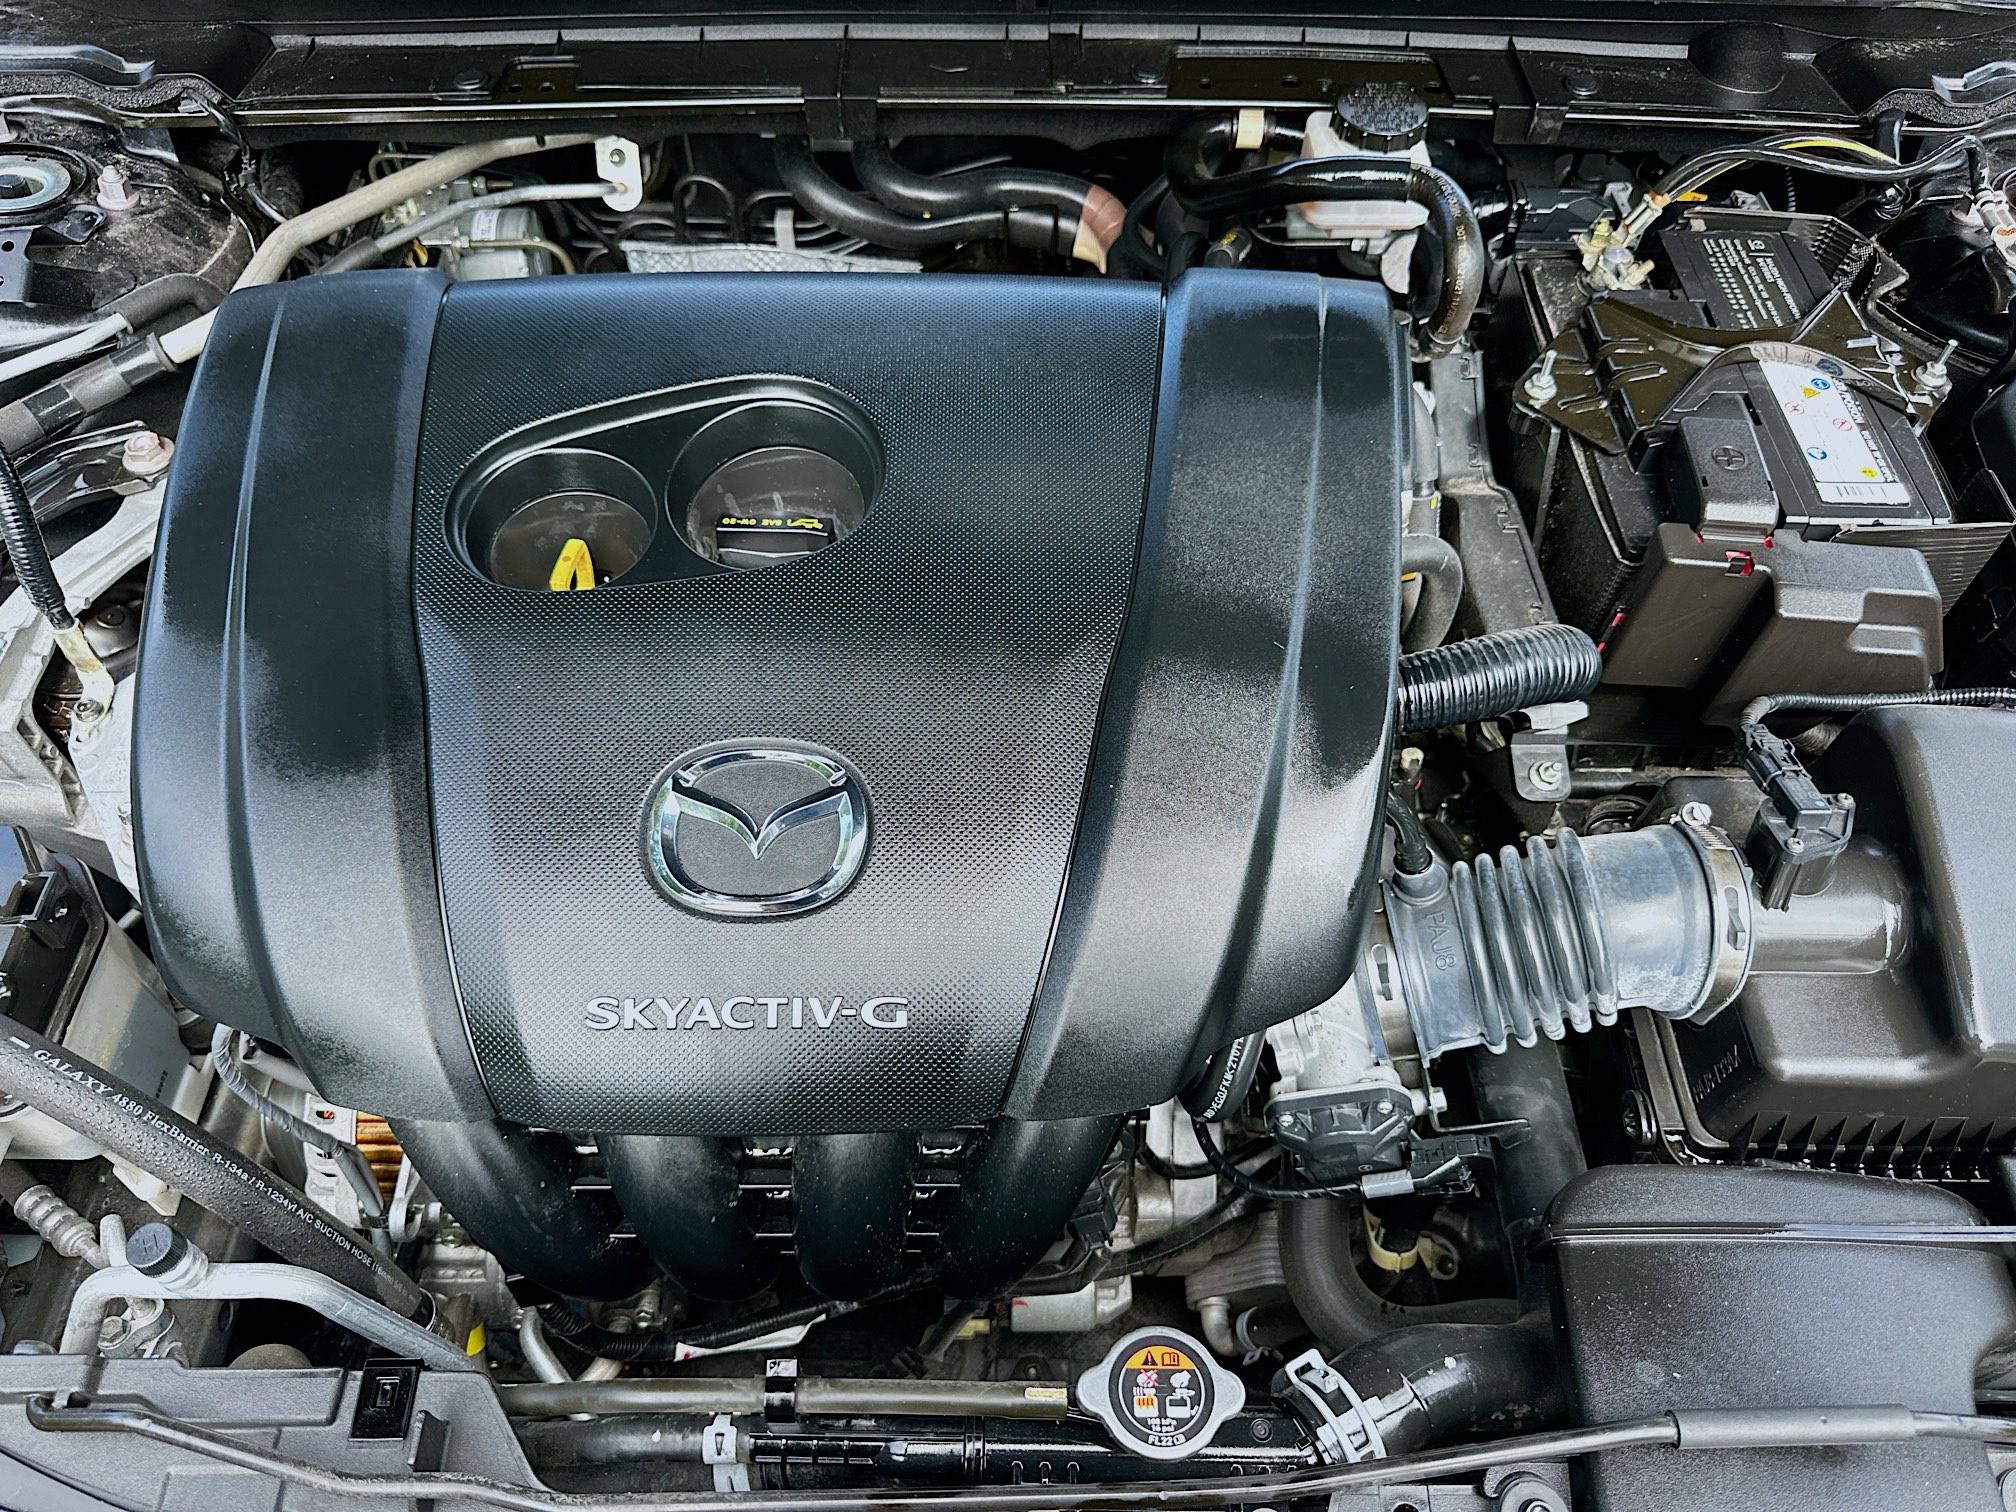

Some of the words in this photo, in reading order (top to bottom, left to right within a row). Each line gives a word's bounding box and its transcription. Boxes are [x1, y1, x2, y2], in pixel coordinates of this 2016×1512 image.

[722, 517, 757, 525] 0W-20
[1425, 910, 1457, 971] PAJ8
[584, 996, 909, 1031] SKYACTIV-G
[34, 1049, 114, 1097] GALAXY
[111, 1093, 144, 1118] 4880
[143, 1110, 211, 1156] FlexBarrier
[211, 1152, 249, 1181] R-134a
[297, 1208, 314, 1226] A/C
[313, 1219, 351, 1251] SUCTION
[350, 1245, 373, 1267] HOSE
[1148, 1434, 1174, 1446] FL22
